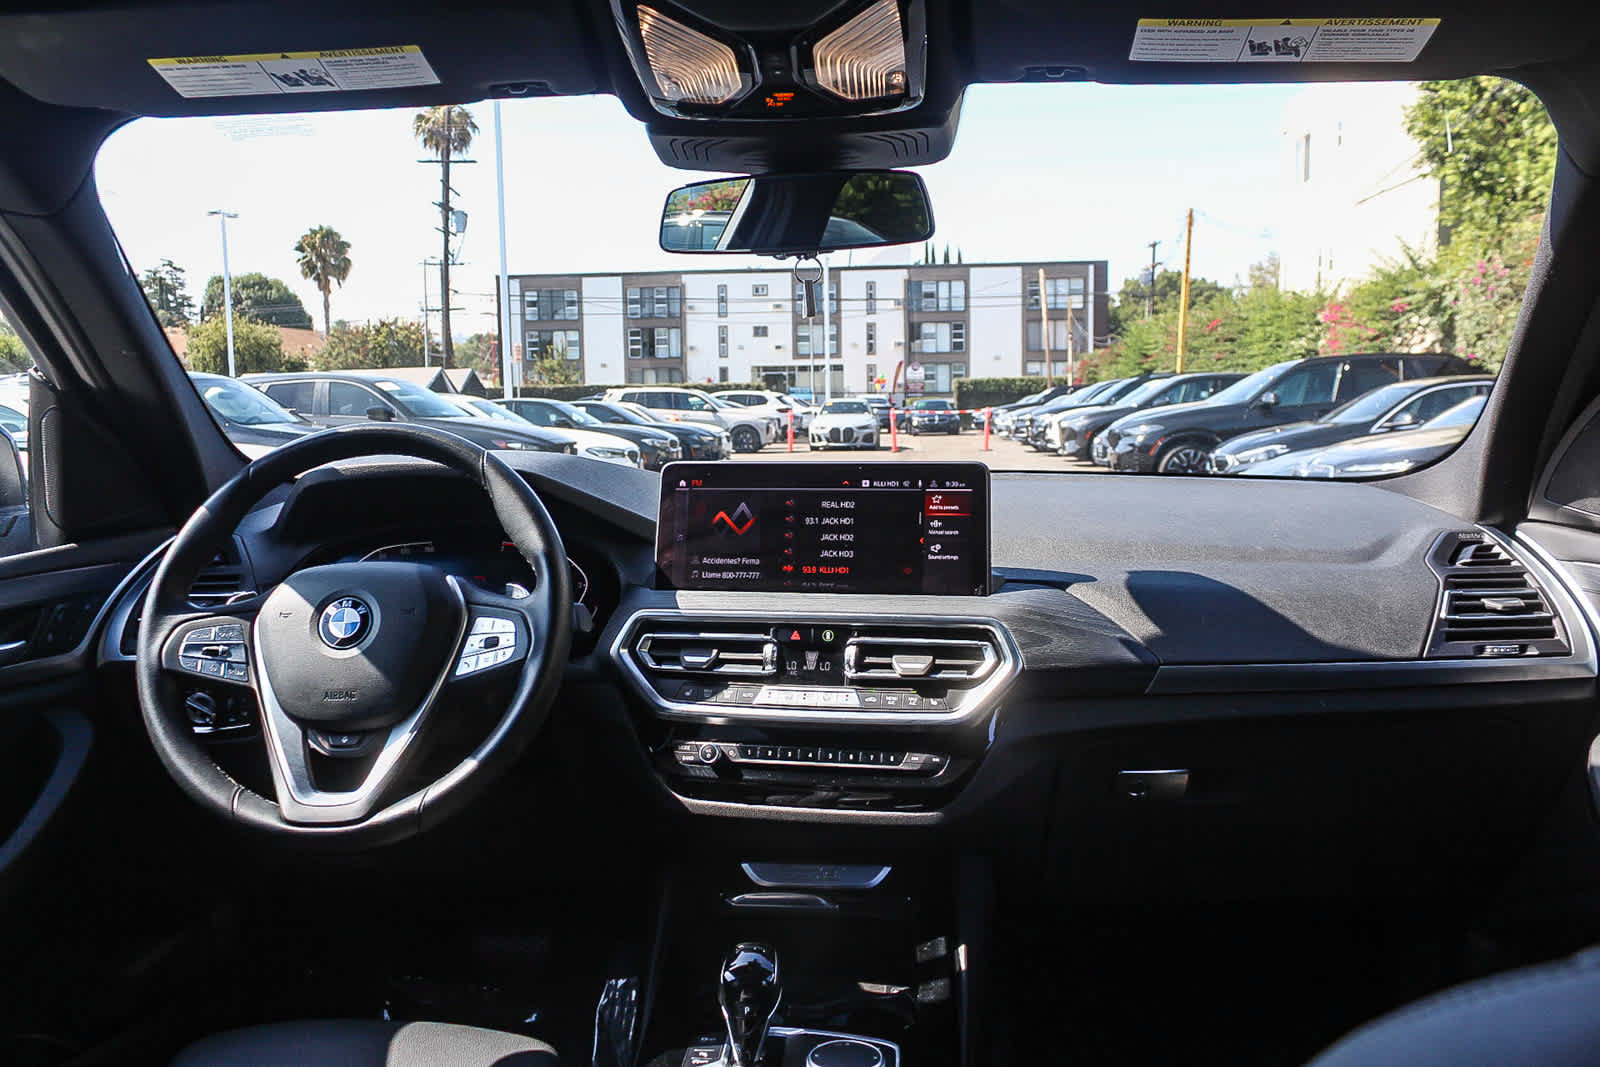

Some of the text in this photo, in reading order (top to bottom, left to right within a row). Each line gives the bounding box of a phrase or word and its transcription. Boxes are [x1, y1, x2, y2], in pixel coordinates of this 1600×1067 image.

[1167, 19, 1222, 27] WARNING
[1325, 18, 1424, 26] AVERTISSEMENT
[319, 47, 406, 58] AVERTISSEMENT
[176, 55, 228, 64] WARNING
[821, 501, 855, 509] REAL HD2
[805, 517, 854, 525] 93.1 JACK HD1
[820, 533, 855, 541] JACK HD2
[820, 549, 854, 558] JACK HD3
[323, 690, 357, 701] AIRBAG
[744, 1006, 750, 1015] P
